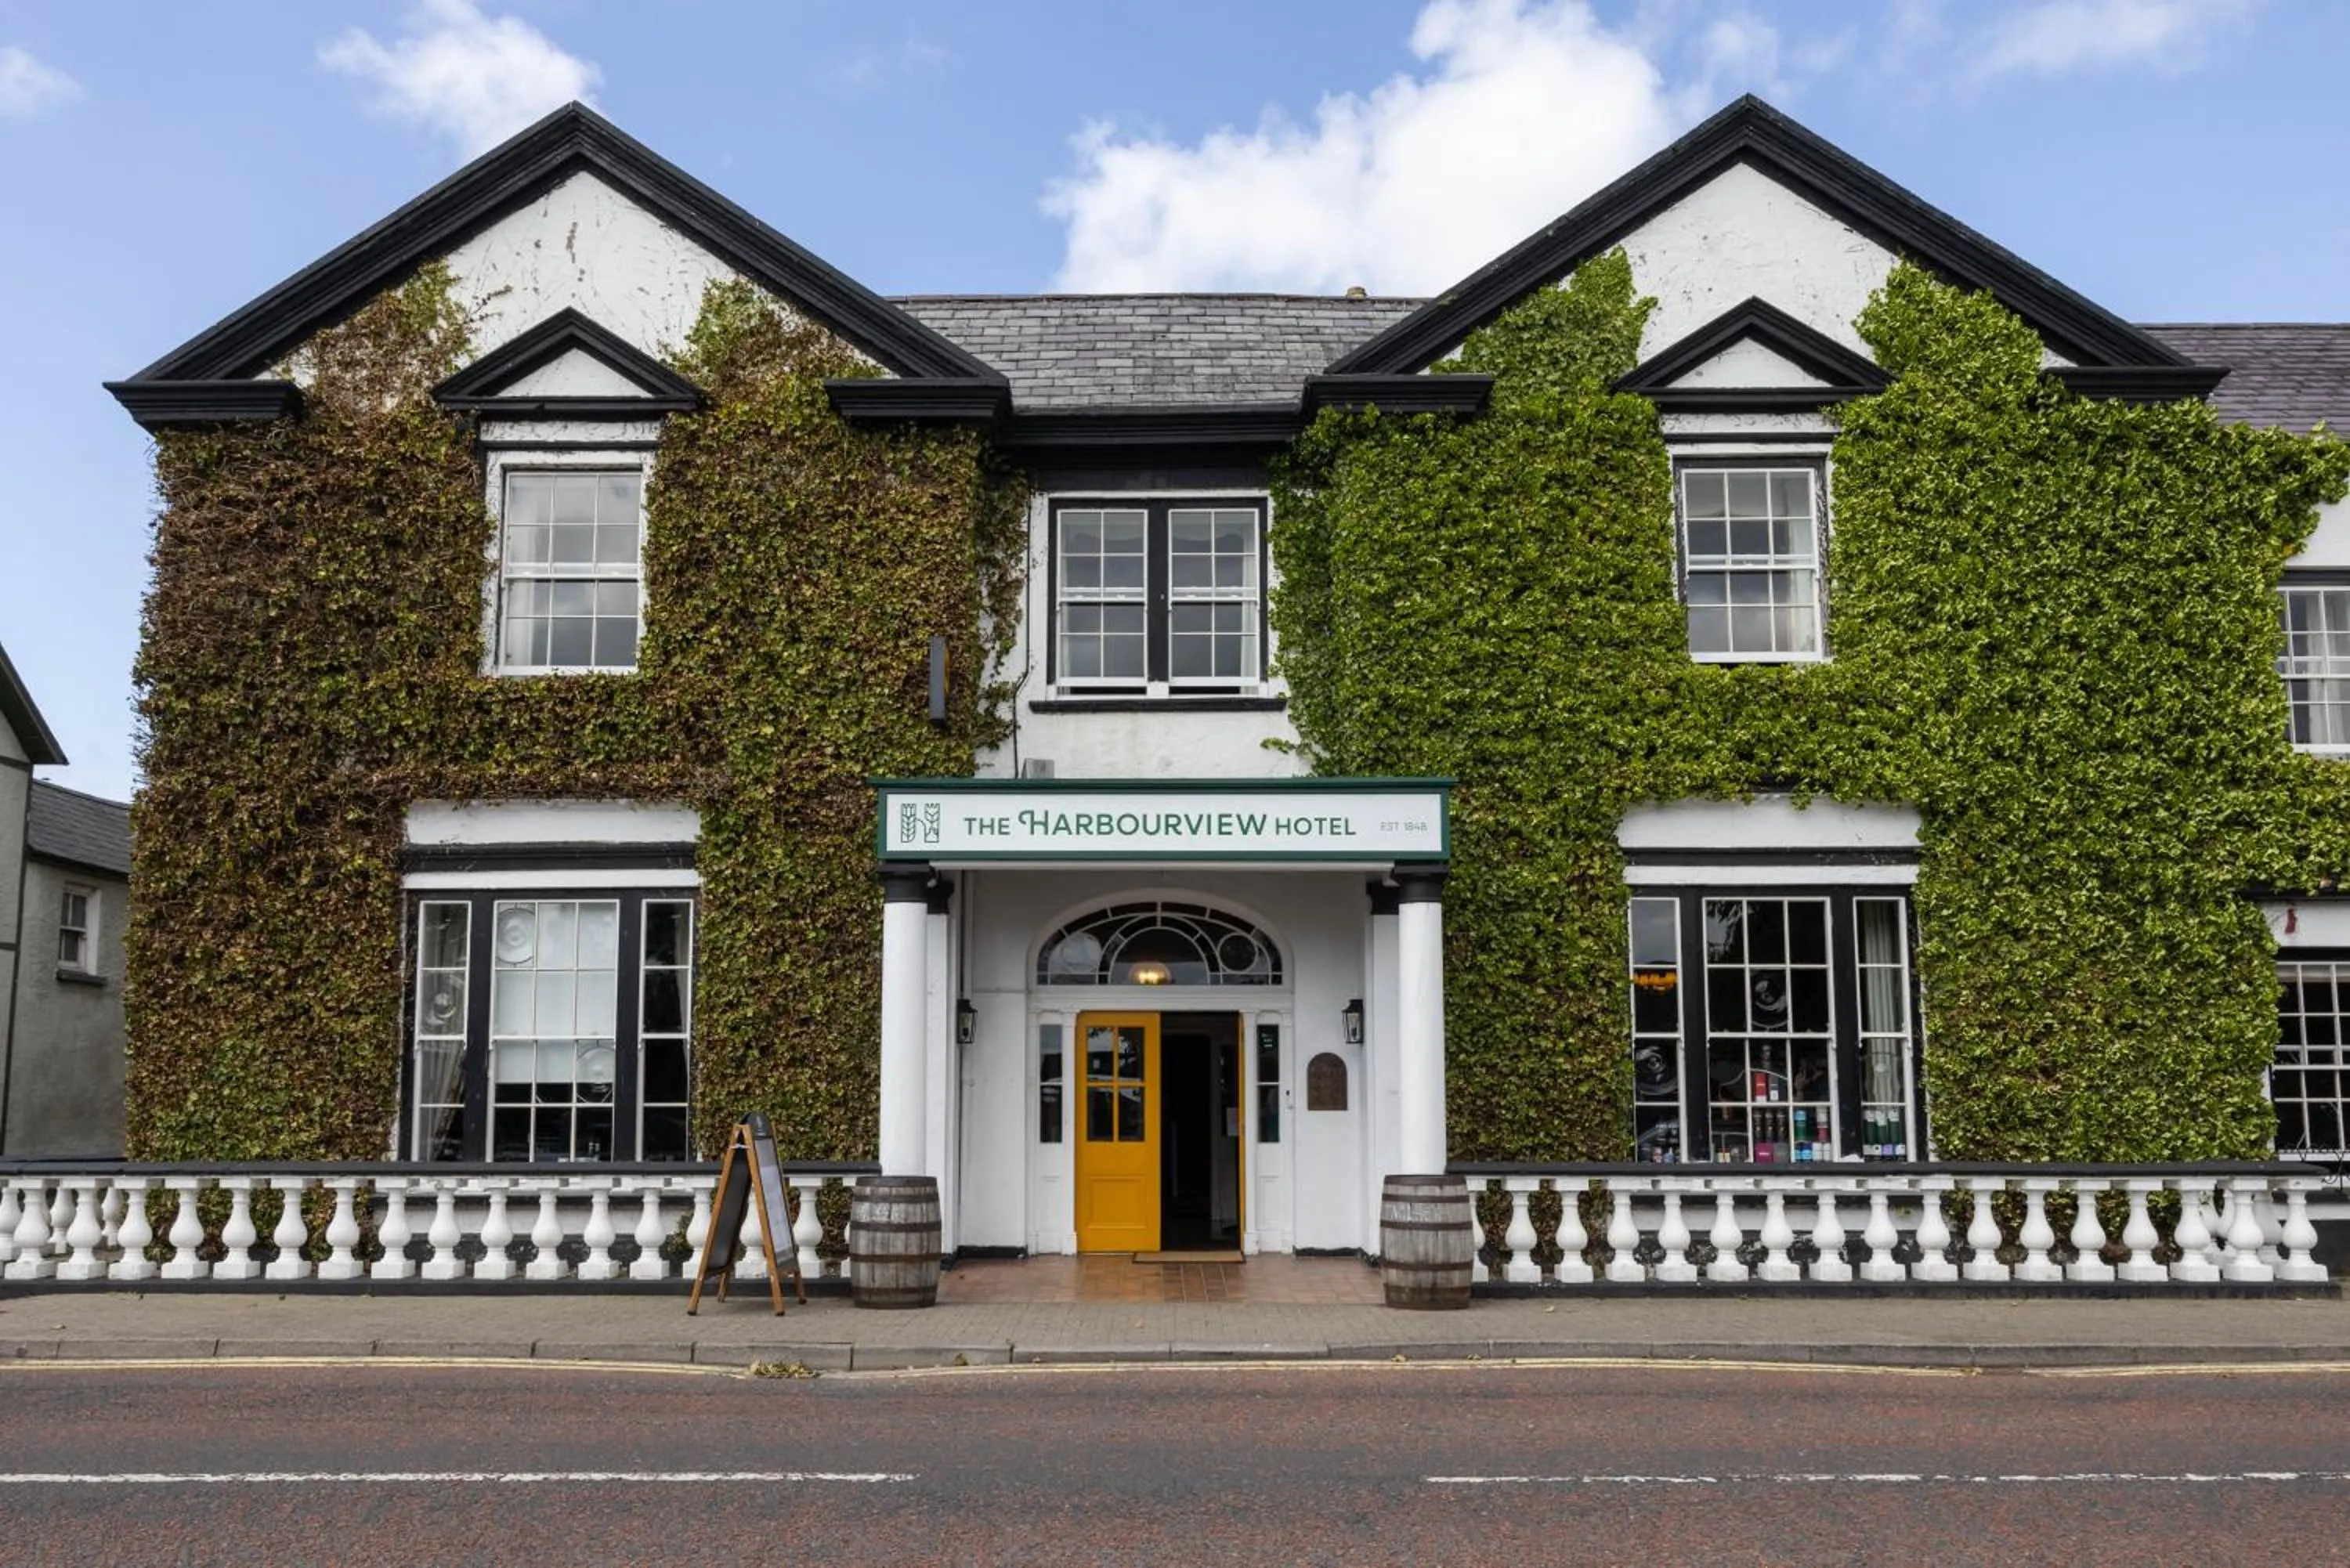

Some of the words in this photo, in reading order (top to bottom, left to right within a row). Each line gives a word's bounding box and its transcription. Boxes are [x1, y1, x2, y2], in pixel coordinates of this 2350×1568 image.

[964, 817, 1010, 836] THE
[1018, 810, 1267, 836] HARBOURVIEW
[1275, 817, 1357, 836] HOTEL
[1379, 821, 1399, 831] EST
